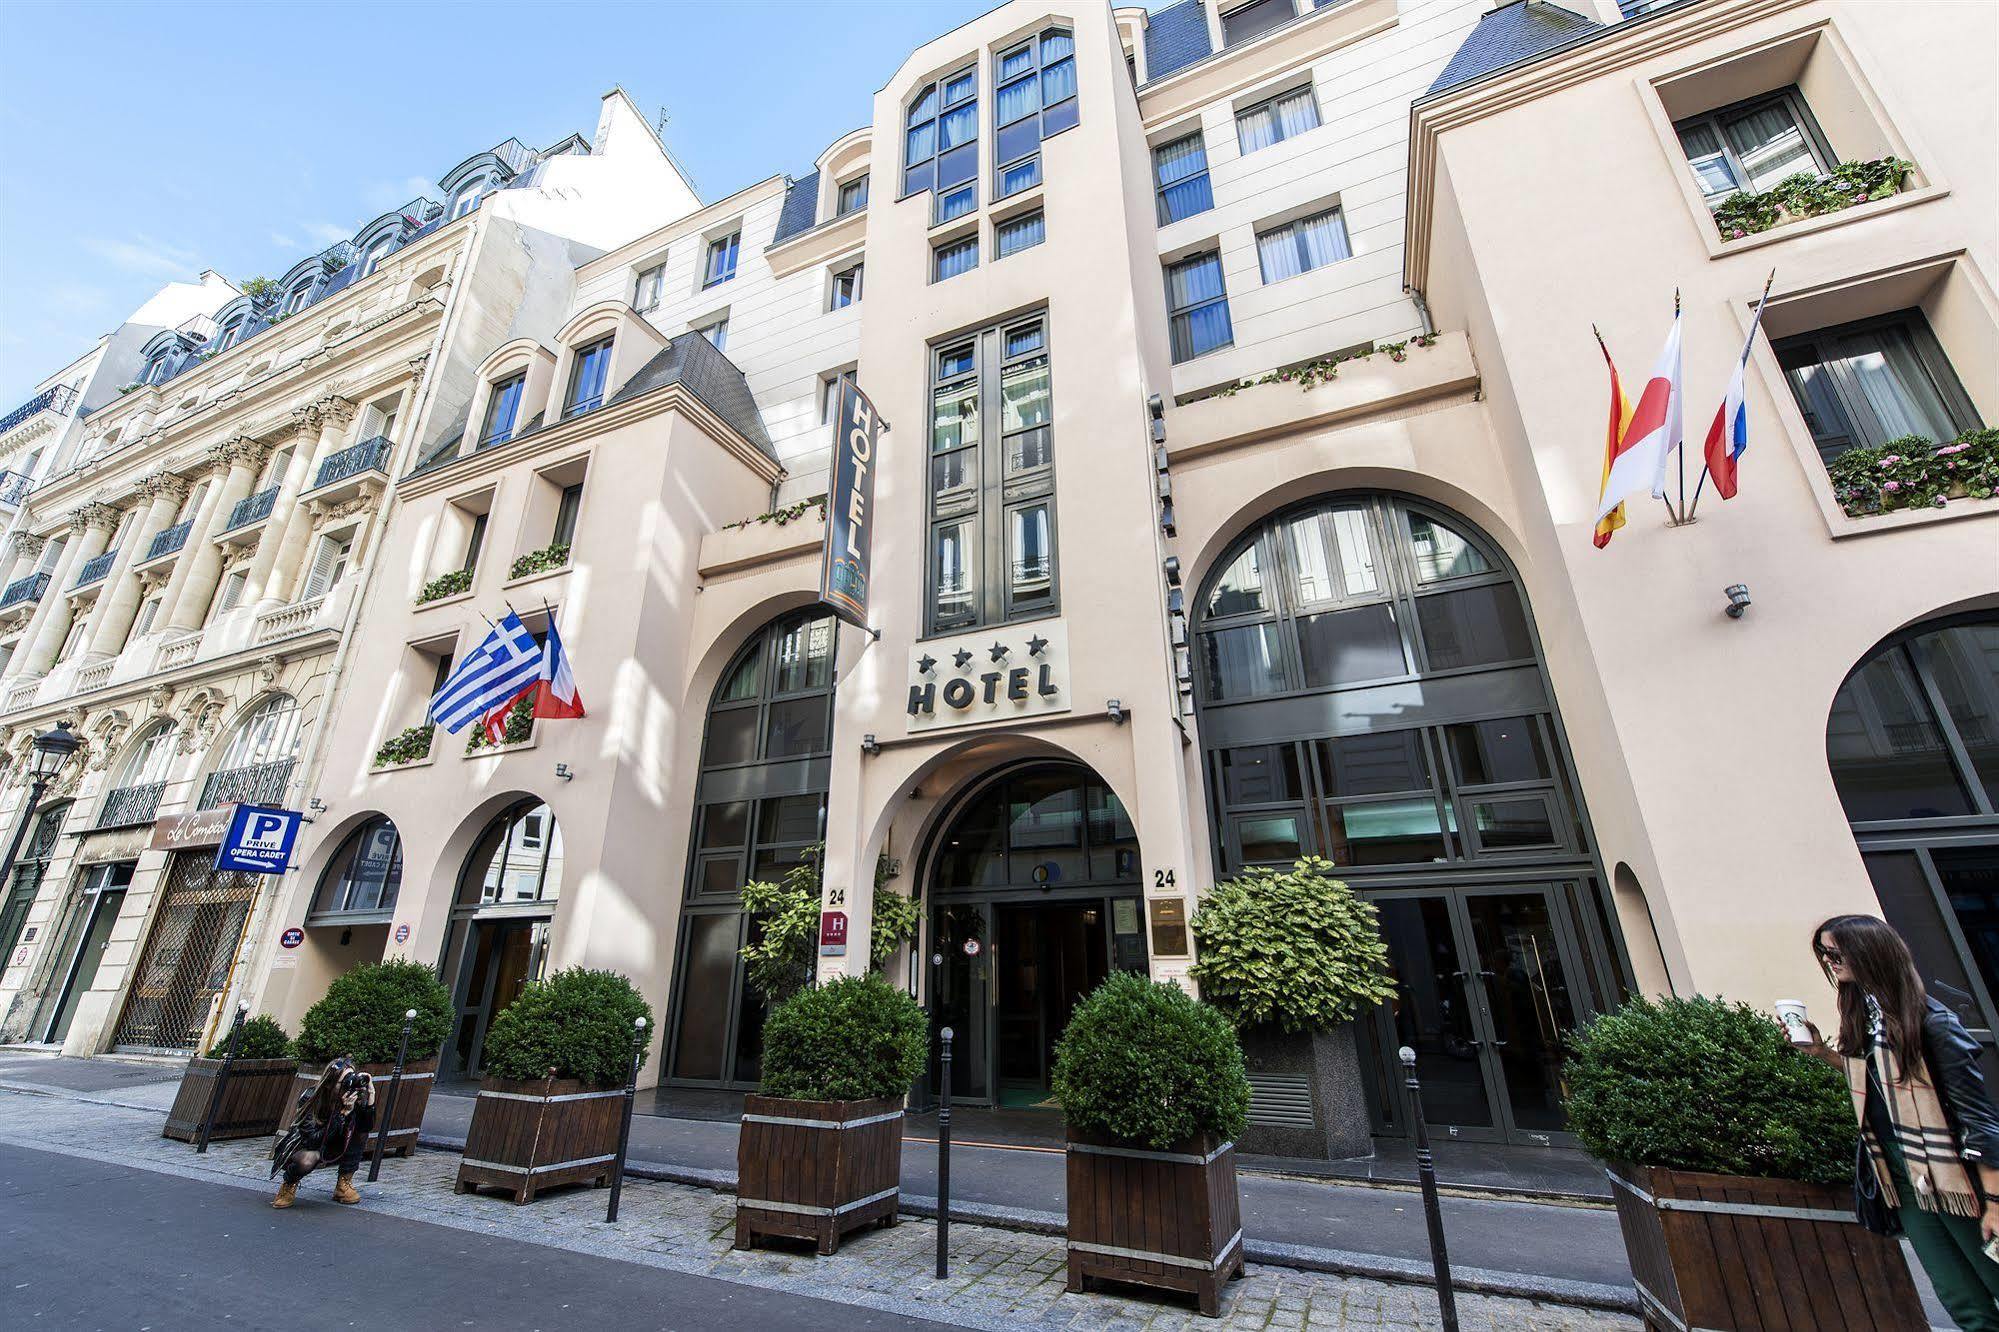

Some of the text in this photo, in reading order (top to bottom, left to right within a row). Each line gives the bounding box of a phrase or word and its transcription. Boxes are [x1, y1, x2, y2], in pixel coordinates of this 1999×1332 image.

[846, 395, 872, 560] HOTEL
[907, 664, 1059, 716] HOTEL
[167, 814, 231, 844] Le Comptoi
[252, 815, 282, 841] P
[246, 839, 278, 849] PRIVÉ
[230, 848, 286, 860] OPERA CADET
[1154, 869, 1176, 888] 24
[829, 889, 845, 905] 24
[832, 917, 845, 931] H
